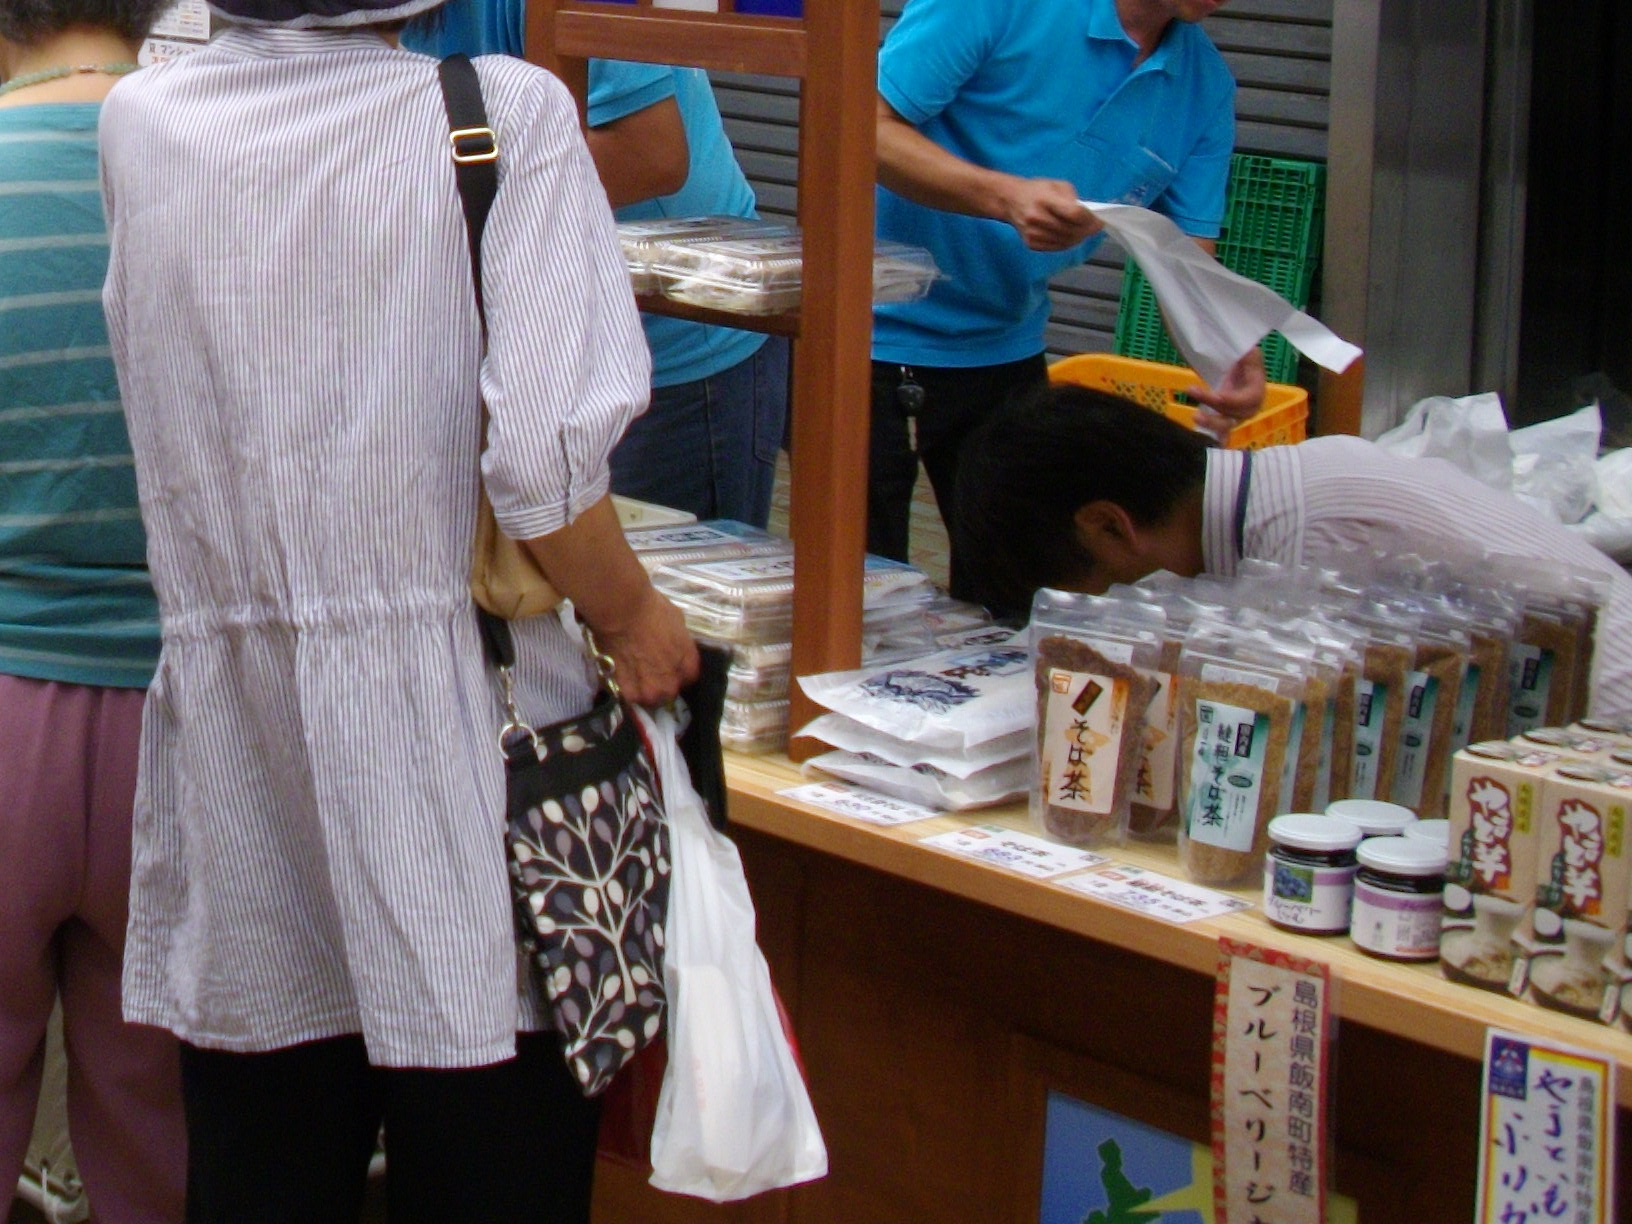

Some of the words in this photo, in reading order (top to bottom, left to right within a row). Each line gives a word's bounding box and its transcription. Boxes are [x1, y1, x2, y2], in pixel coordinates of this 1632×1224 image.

[1238, 984, 1280, 1224] ブルーベリージ
[1288, 980, 1318, 1196] 島根県飯南町特産
